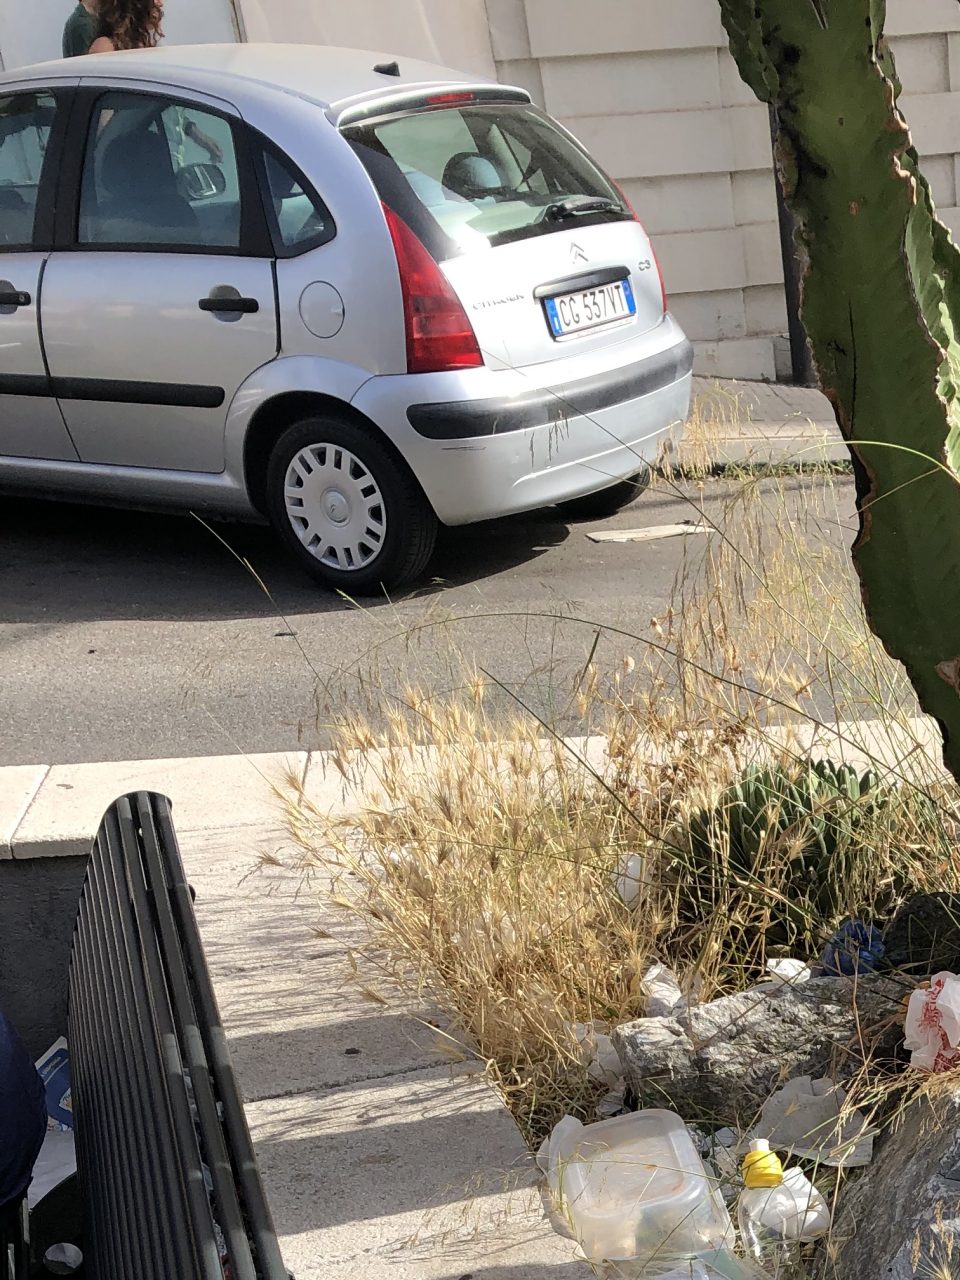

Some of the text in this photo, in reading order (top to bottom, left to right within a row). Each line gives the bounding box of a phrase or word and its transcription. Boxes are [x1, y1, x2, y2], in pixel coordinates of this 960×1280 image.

[637, 259, 652, 272] C3
[559, 284, 625, 327] CG 537VT
